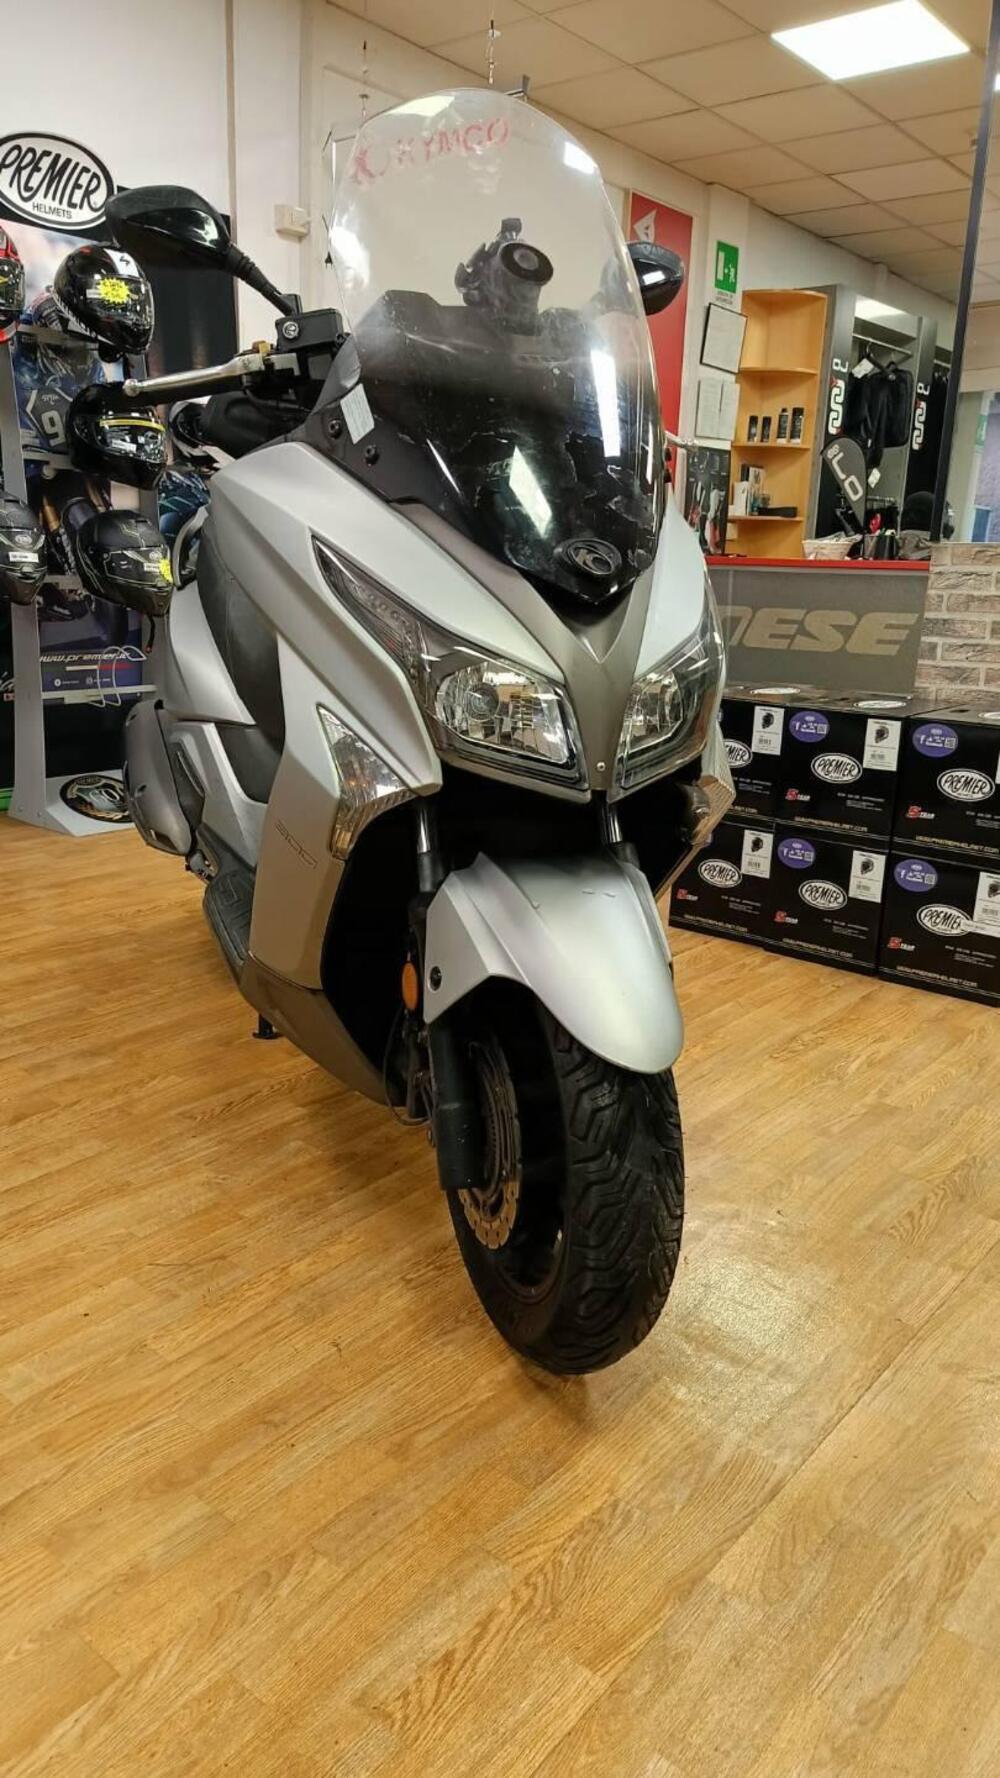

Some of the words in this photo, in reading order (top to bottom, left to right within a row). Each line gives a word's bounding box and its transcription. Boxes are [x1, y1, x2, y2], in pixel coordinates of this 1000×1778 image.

[0, 144, 105, 212] PREMIER
[32, 202, 73, 220] HELMETS
[41, 409, 66, 446] 9
[816, 757, 857, 778] PREMIER
[942, 774, 989, 796] PREMIER
[804, 883, 842, 905] PREMIER
